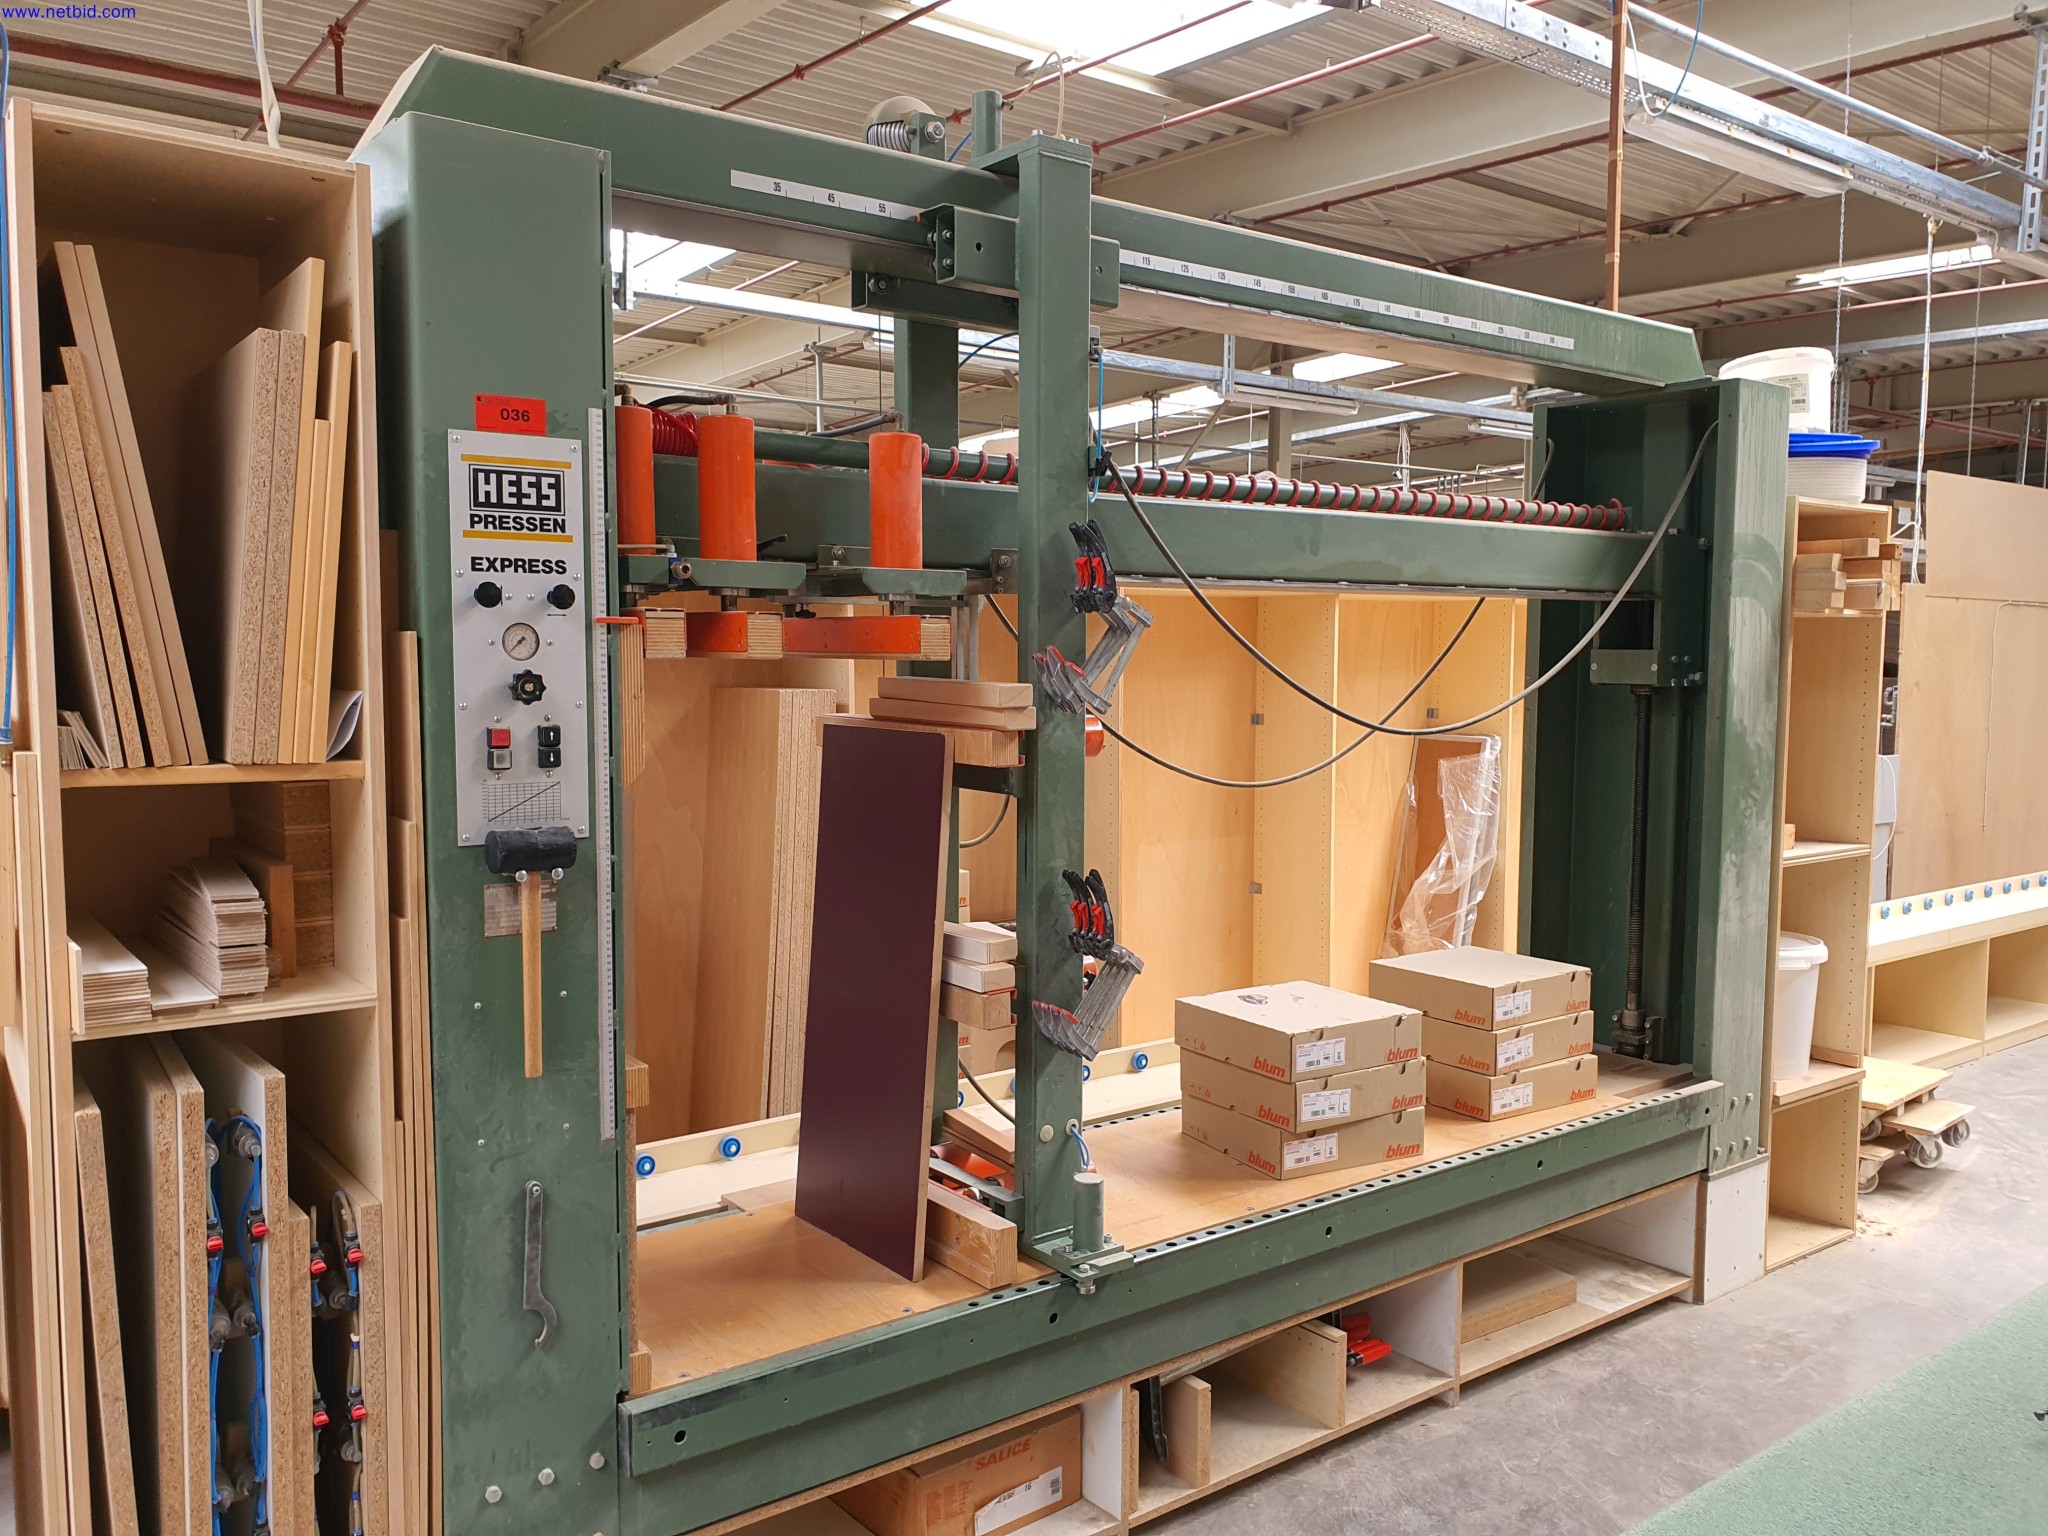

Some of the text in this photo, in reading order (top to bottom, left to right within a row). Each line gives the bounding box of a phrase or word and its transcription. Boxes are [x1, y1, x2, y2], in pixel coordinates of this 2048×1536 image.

[773, 182, 887, 214] 35 45 55
[1142, 256, 1151, 266] 115
[1180, 264, 1190, 274] 125
[1217, 271, 1226, 281] 135
[1253, 278, 1262, 288] 145
[1352, 298, 1361, 307] 175
[500, 407, 531, 423] 036
[477, 471, 557, 508] HESS
[469, 513, 567, 534] PRESSEN
[470, 556, 568, 576] EXPRESS
[1565, 999, 1589, 1013] blum
[1453, 1008, 1486, 1026] blum
[1386, 1047, 1418, 1063] blum
[1568, 1042, 1591, 1055] blum
[1252, 1055, 1286, 1079] blum
[1458, 1054, 1491, 1072] blum
[1391, 1094, 1423, 1110] blum
[1569, 1087, 1595, 1102] blum
[1257, 1104, 1291, 1128] blum
[1453, 1098, 1485, 1117] blum
[1385, 1143, 1421, 1159] blum
[1247, 1149, 1277, 1175] blum
[975, 1438, 1032, 1472] SALICE
